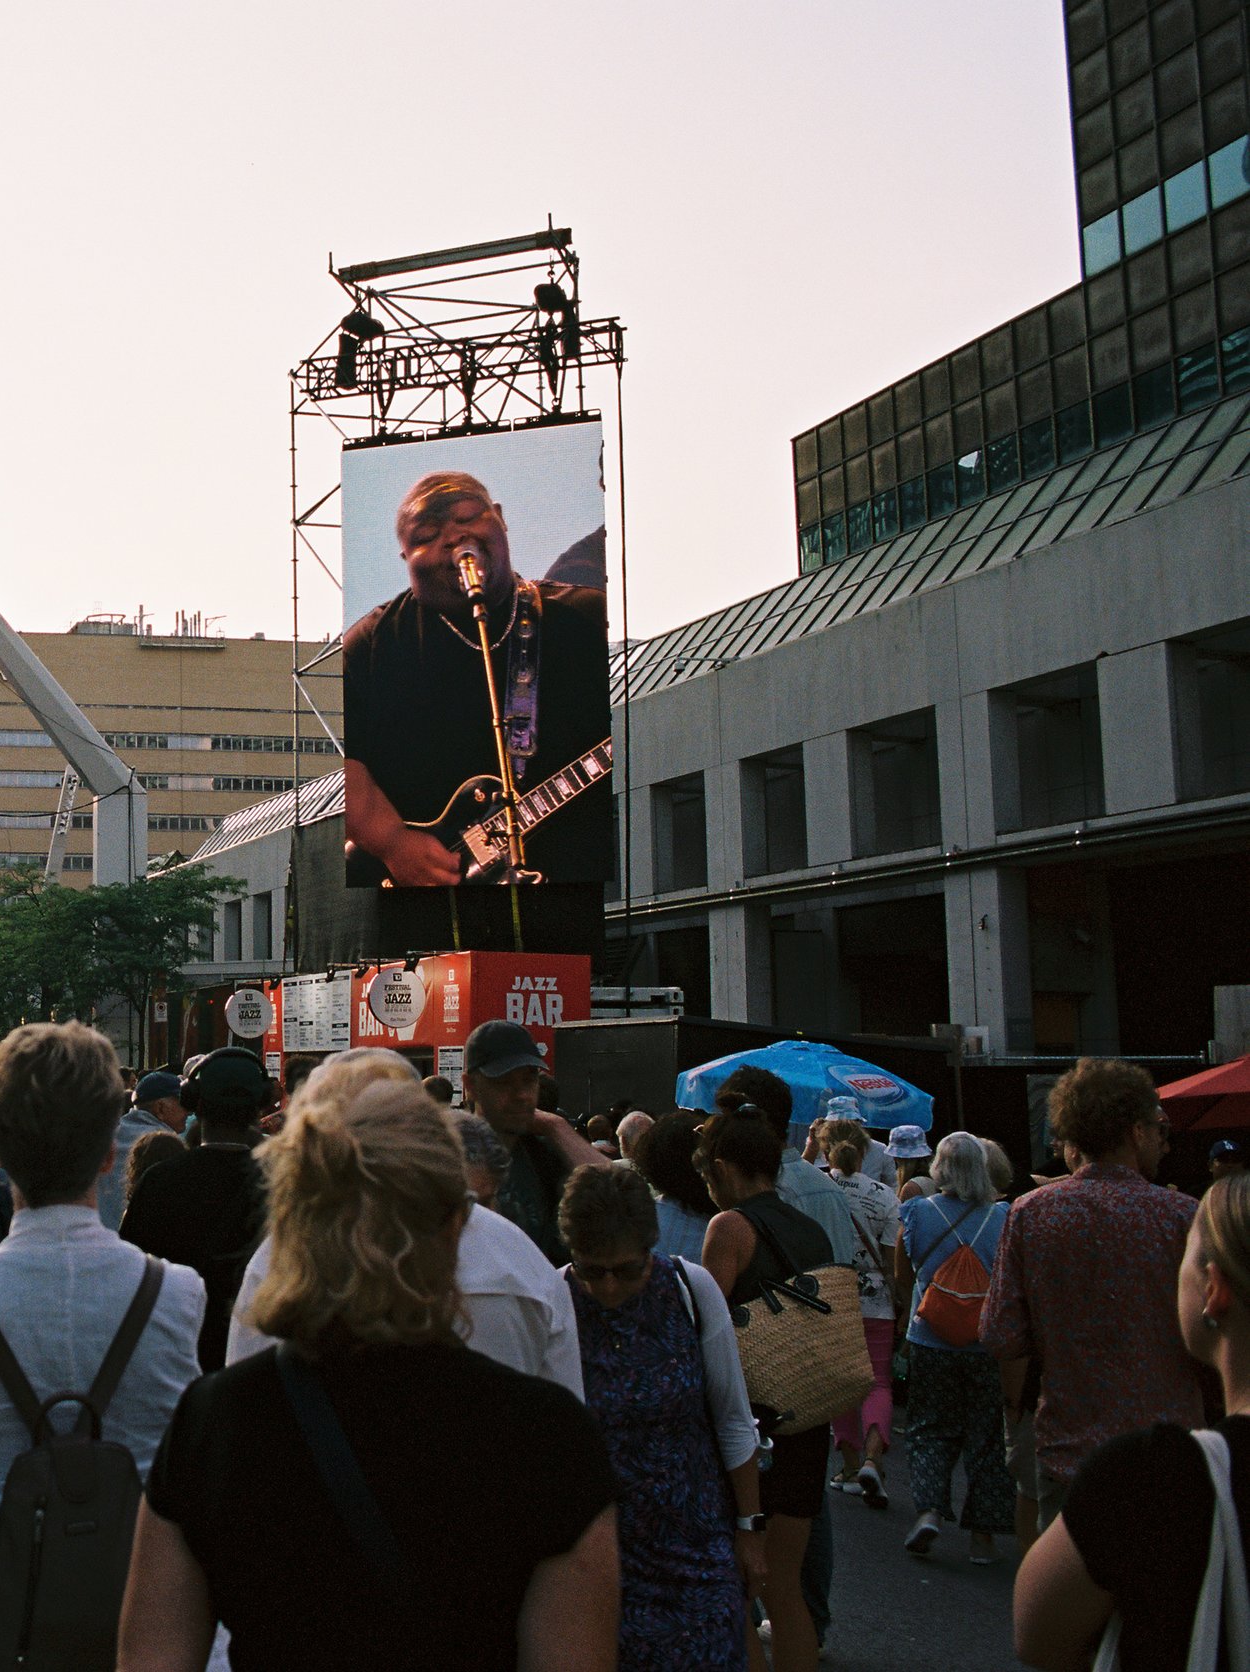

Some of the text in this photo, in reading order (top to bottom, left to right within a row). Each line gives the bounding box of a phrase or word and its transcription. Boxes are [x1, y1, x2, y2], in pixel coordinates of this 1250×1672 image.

[511, 976, 558, 991] JAZZ
[385, 993, 411, 1004] JAZZ
[239, 1010, 261, 1019] JAZZ
[506, 993, 563, 1026] BAR
